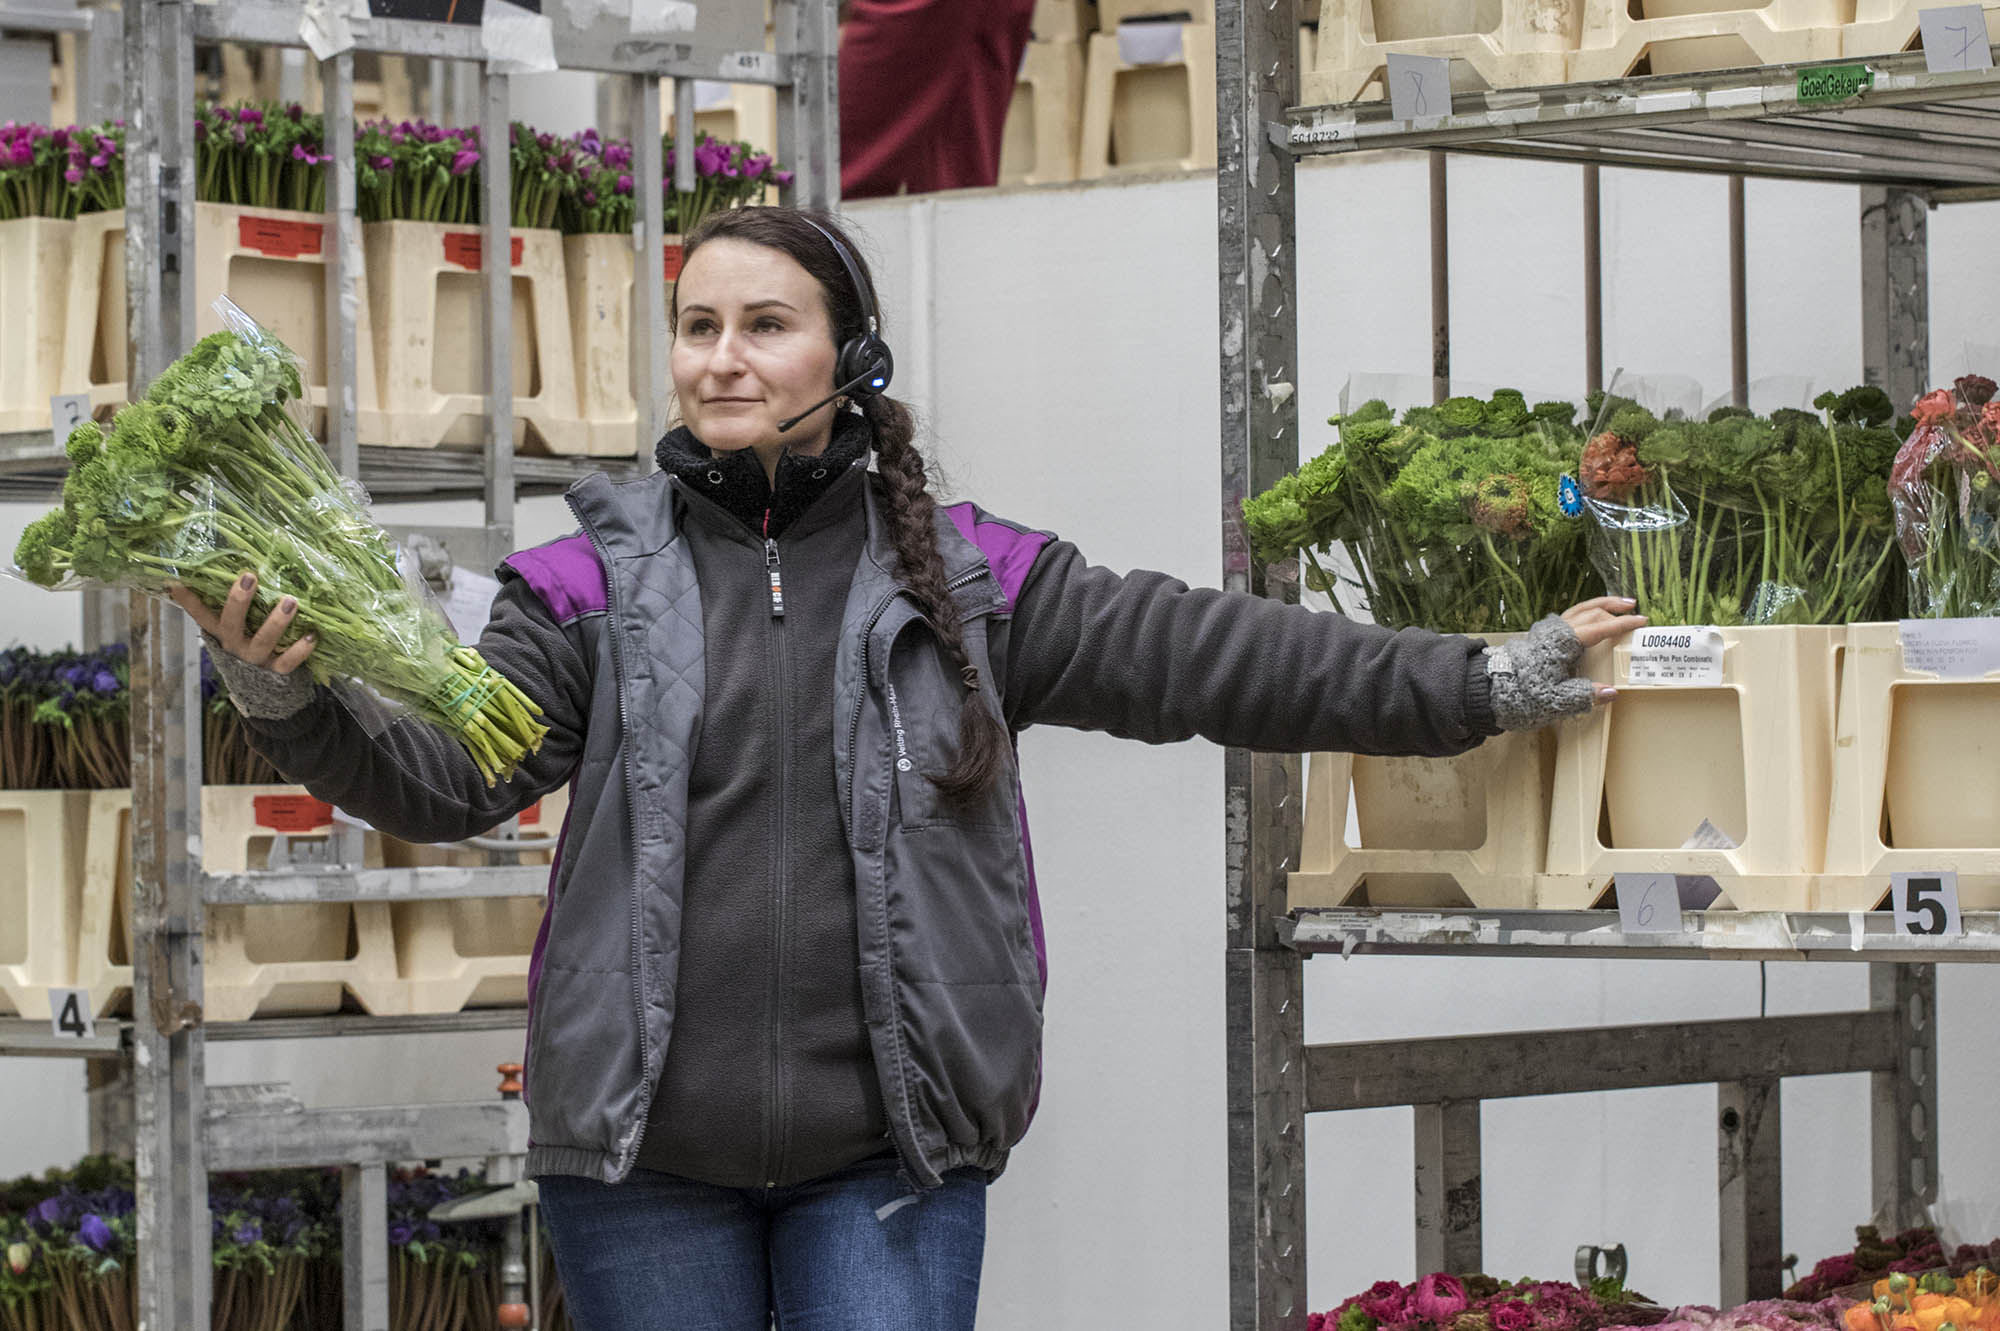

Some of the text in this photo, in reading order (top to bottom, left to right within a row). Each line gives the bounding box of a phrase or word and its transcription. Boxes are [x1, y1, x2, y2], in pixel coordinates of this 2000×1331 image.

[1944, 26, 1984, 71] 7
[1404, 70, 1428, 117] 8
[1641, 634, 1692, 649] L0084408
[1637, 880, 1657, 927] 6
[1905, 877, 1948, 935] 5
[59, 992, 87, 1038] 4
